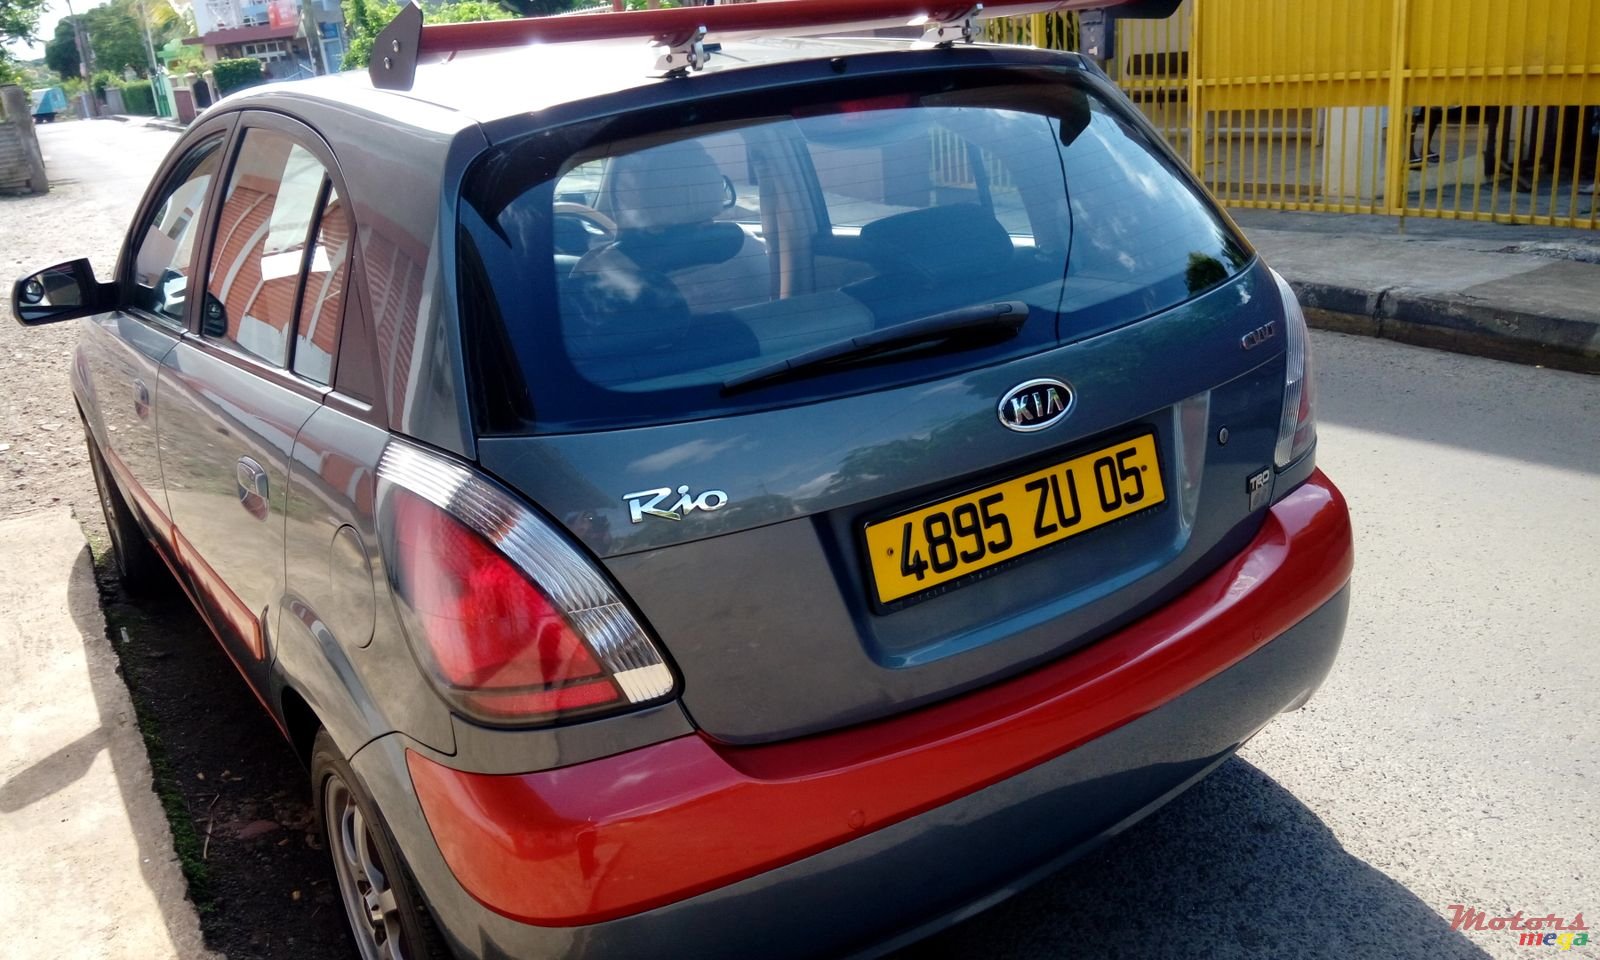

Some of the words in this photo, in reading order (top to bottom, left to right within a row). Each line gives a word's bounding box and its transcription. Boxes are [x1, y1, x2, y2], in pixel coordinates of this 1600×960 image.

[1011, 387, 1064, 425] KIA
[1249, 469, 1270, 490] TRD
[622, 484, 728, 523] Rio
[901, 492, 1013, 581] 4895
[1025, 469, 1082, 539] ZU
[1093, 447, 1145, 513] 05
